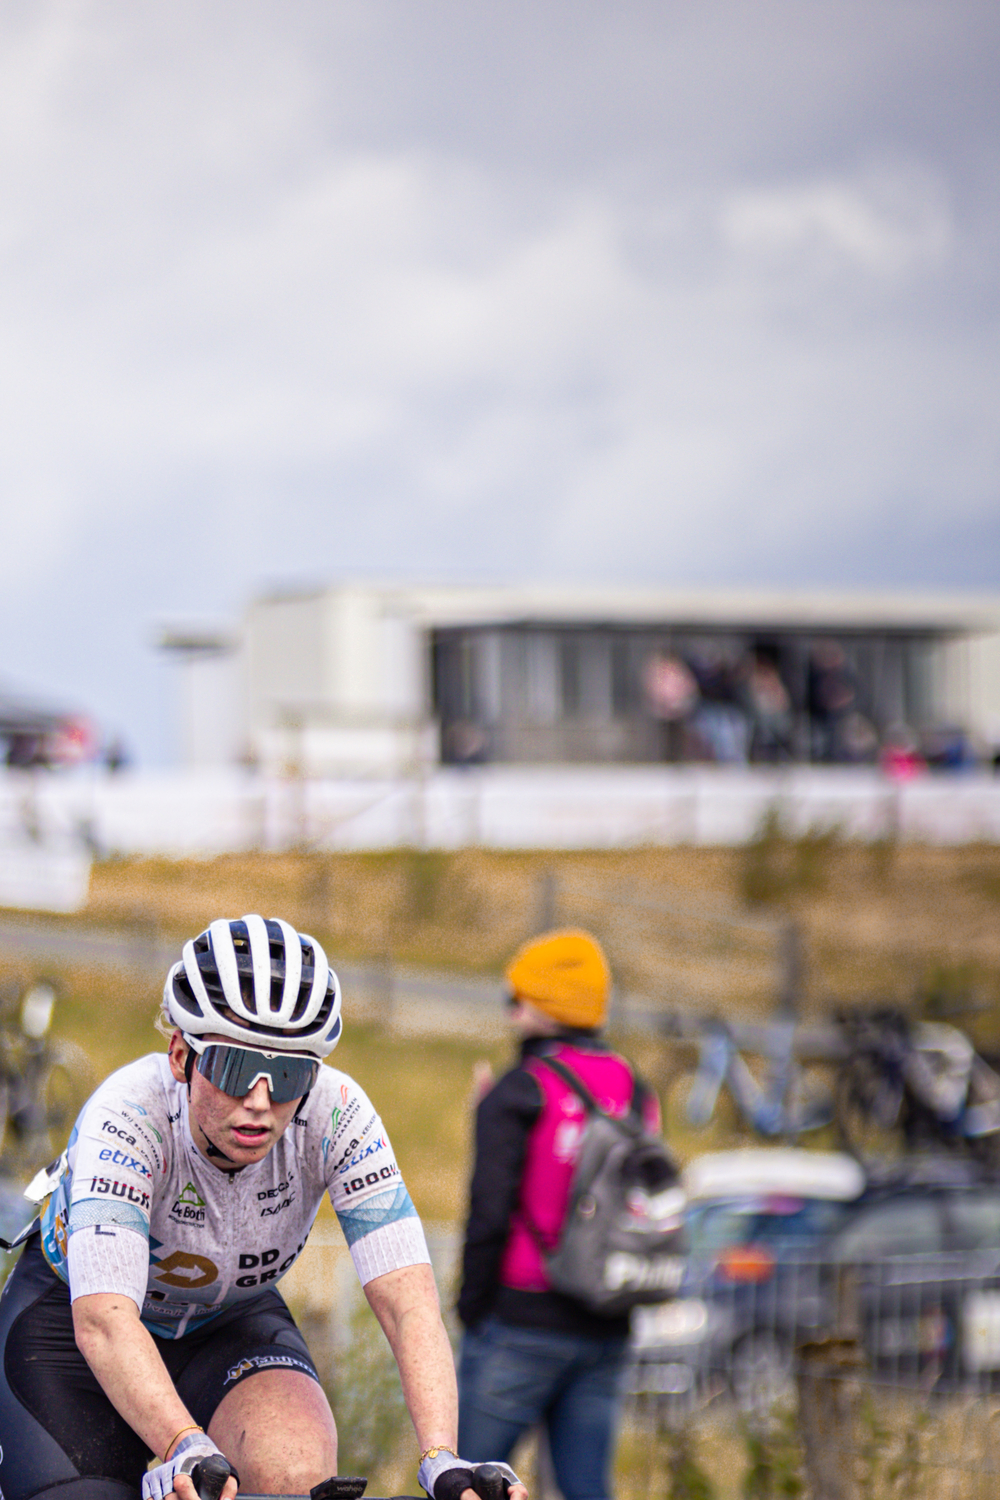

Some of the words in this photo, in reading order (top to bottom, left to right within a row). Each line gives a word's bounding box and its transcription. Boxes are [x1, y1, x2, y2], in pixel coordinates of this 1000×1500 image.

[101, 1120, 137, 1146] foca
[99, 1148, 150, 1175] etixx
[239, 1249, 280, 1270] DD
